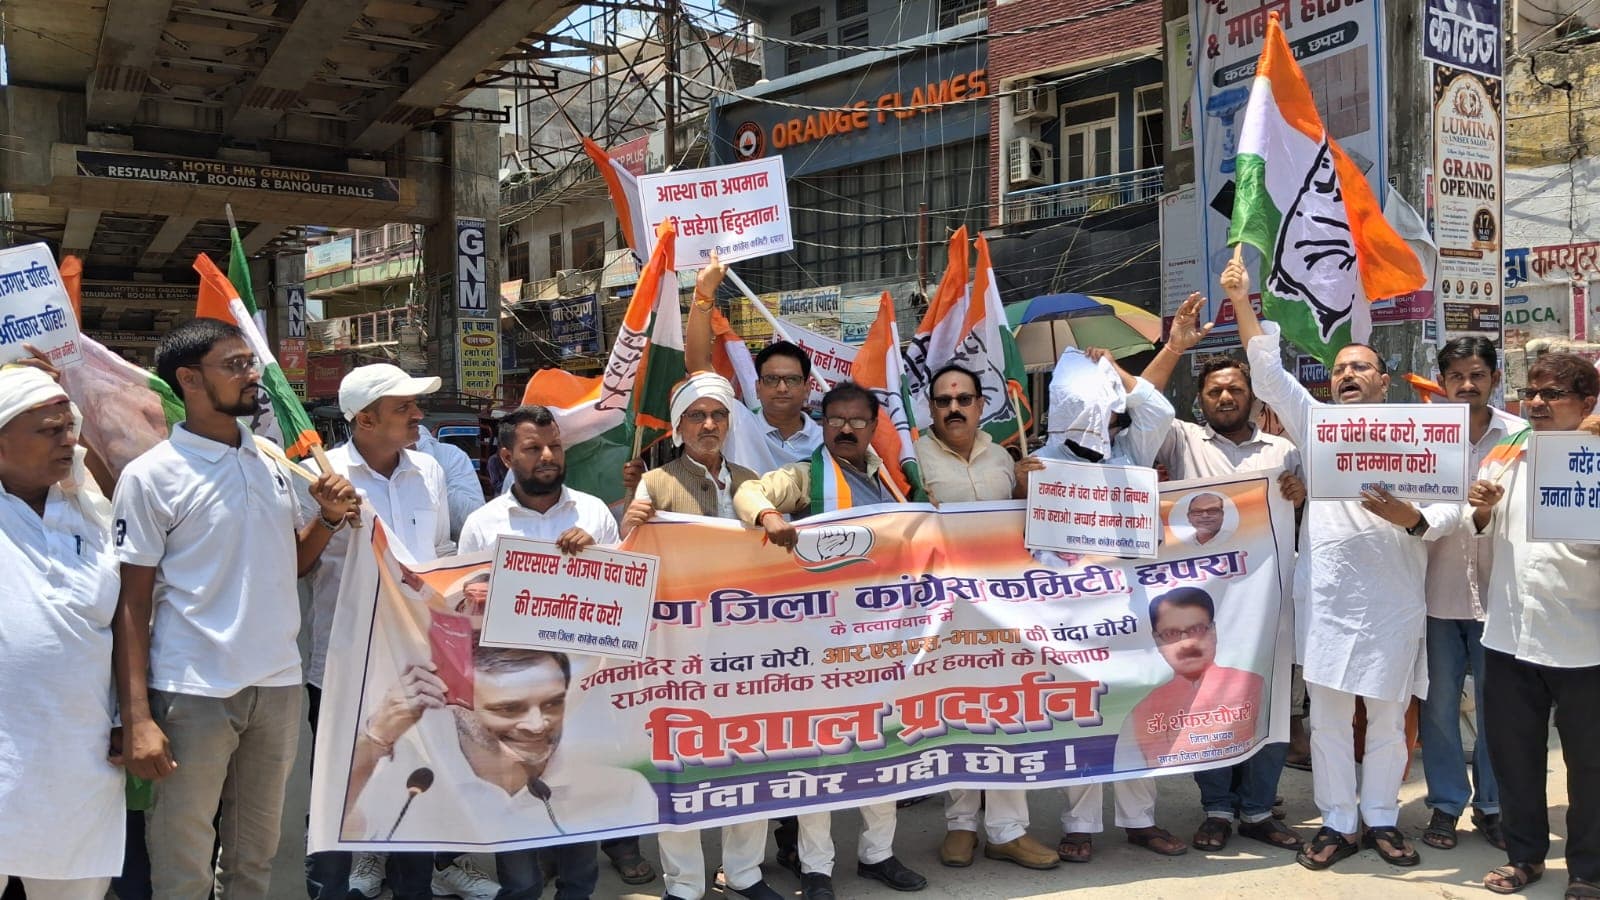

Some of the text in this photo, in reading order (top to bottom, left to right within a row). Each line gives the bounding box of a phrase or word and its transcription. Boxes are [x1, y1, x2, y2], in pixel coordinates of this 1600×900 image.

[1308, 30, 1345, 52] छपरा
[772, 100, 871, 149] ORANGE
[876, 69, 989, 125] FLAMES
[1441, 116, 1495, 141] LUMINA
[182, 160, 310, 182] HOTEL HM GRAND
[626, 149, 644, 167] PLUS
[1443, 158, 1493, 182] GRAND
[108, 165, 374, 198] RESTAURANT, ROOMS & BANQUET HALLS
[656, 171, 769, 202] आस्था का अपमान
[1440, 177, 1495, 201] OPENING
[681, 205, 780, 236] सहेगा हिंदुस्तान!
[459, 228, 486, 307] GNM
[37, 304, 67, 333] चाहिए!
[289, 290, 305, 336] ANM
[813, 346, 833, 373] कहाँ
[1317, 417, 1461, 446] चंदा चोरी बंद करो, जनता
[1336, 448, 1437, 473] का सम्मान करो!
[1568, 446, 1594, 475] नरेंद्र
[1038, 481, 1066, 498] राममंदिर
[1069, 483, 1077, 499] में
[1077, 485, 1090, 499] चंदा
[1092, 485, 1108, 501] चोरी
[1110, 487, 1121, 502] की
[1540, 480, 1586, 507] जनता के
[1033, 505, 1046, 521] जांच
[1047, 508, 1071, 524] कराओ!
[1074, 511, 1096, 527] सच्चाई
[1099, 512, 1122, 528] सामने
[116, 519, 126, 547] 3
[503, 550, 560, 575] आरएसएस
[603, 558, 623, 583] चंदा
[624, 561, 648, 588] चोरी
[710, 589, 833, 623] जिला
[855, 574, 980, 609] कांग्रेस
[1134, 550, 1241, 586] छपरा
[514, 589, 624, 627] की राजनीति बंद करो!
[830, 607, 954, 636] के तत्वावधान में
[682, 653, 704, 675] में
[710, 652, 754, 673] चंदा
[1024, 624, 1049, 643] की
[1051, 622, 1090, 643] चंदा
[1093, 616, 1138, 638] चोरी
[611, 646, 1110, 710] राजनीति व धार्मिक संस्थानों पर हमलों के खिलाफ
[644, 671, 1101, 762] विशाल प्रदर्शन
[1169, 709, 1212, 731] शंकर
[1212, 702, 1252, 724] चौधरी
[1190, 733, 1209, 743] जिला
[1180, 751, 1200, 761] जिला
[670, 783, 759, 814] चंदा
[768, 771, 848, 800] चोर
[963, 746, 1048, 781] छोड़
